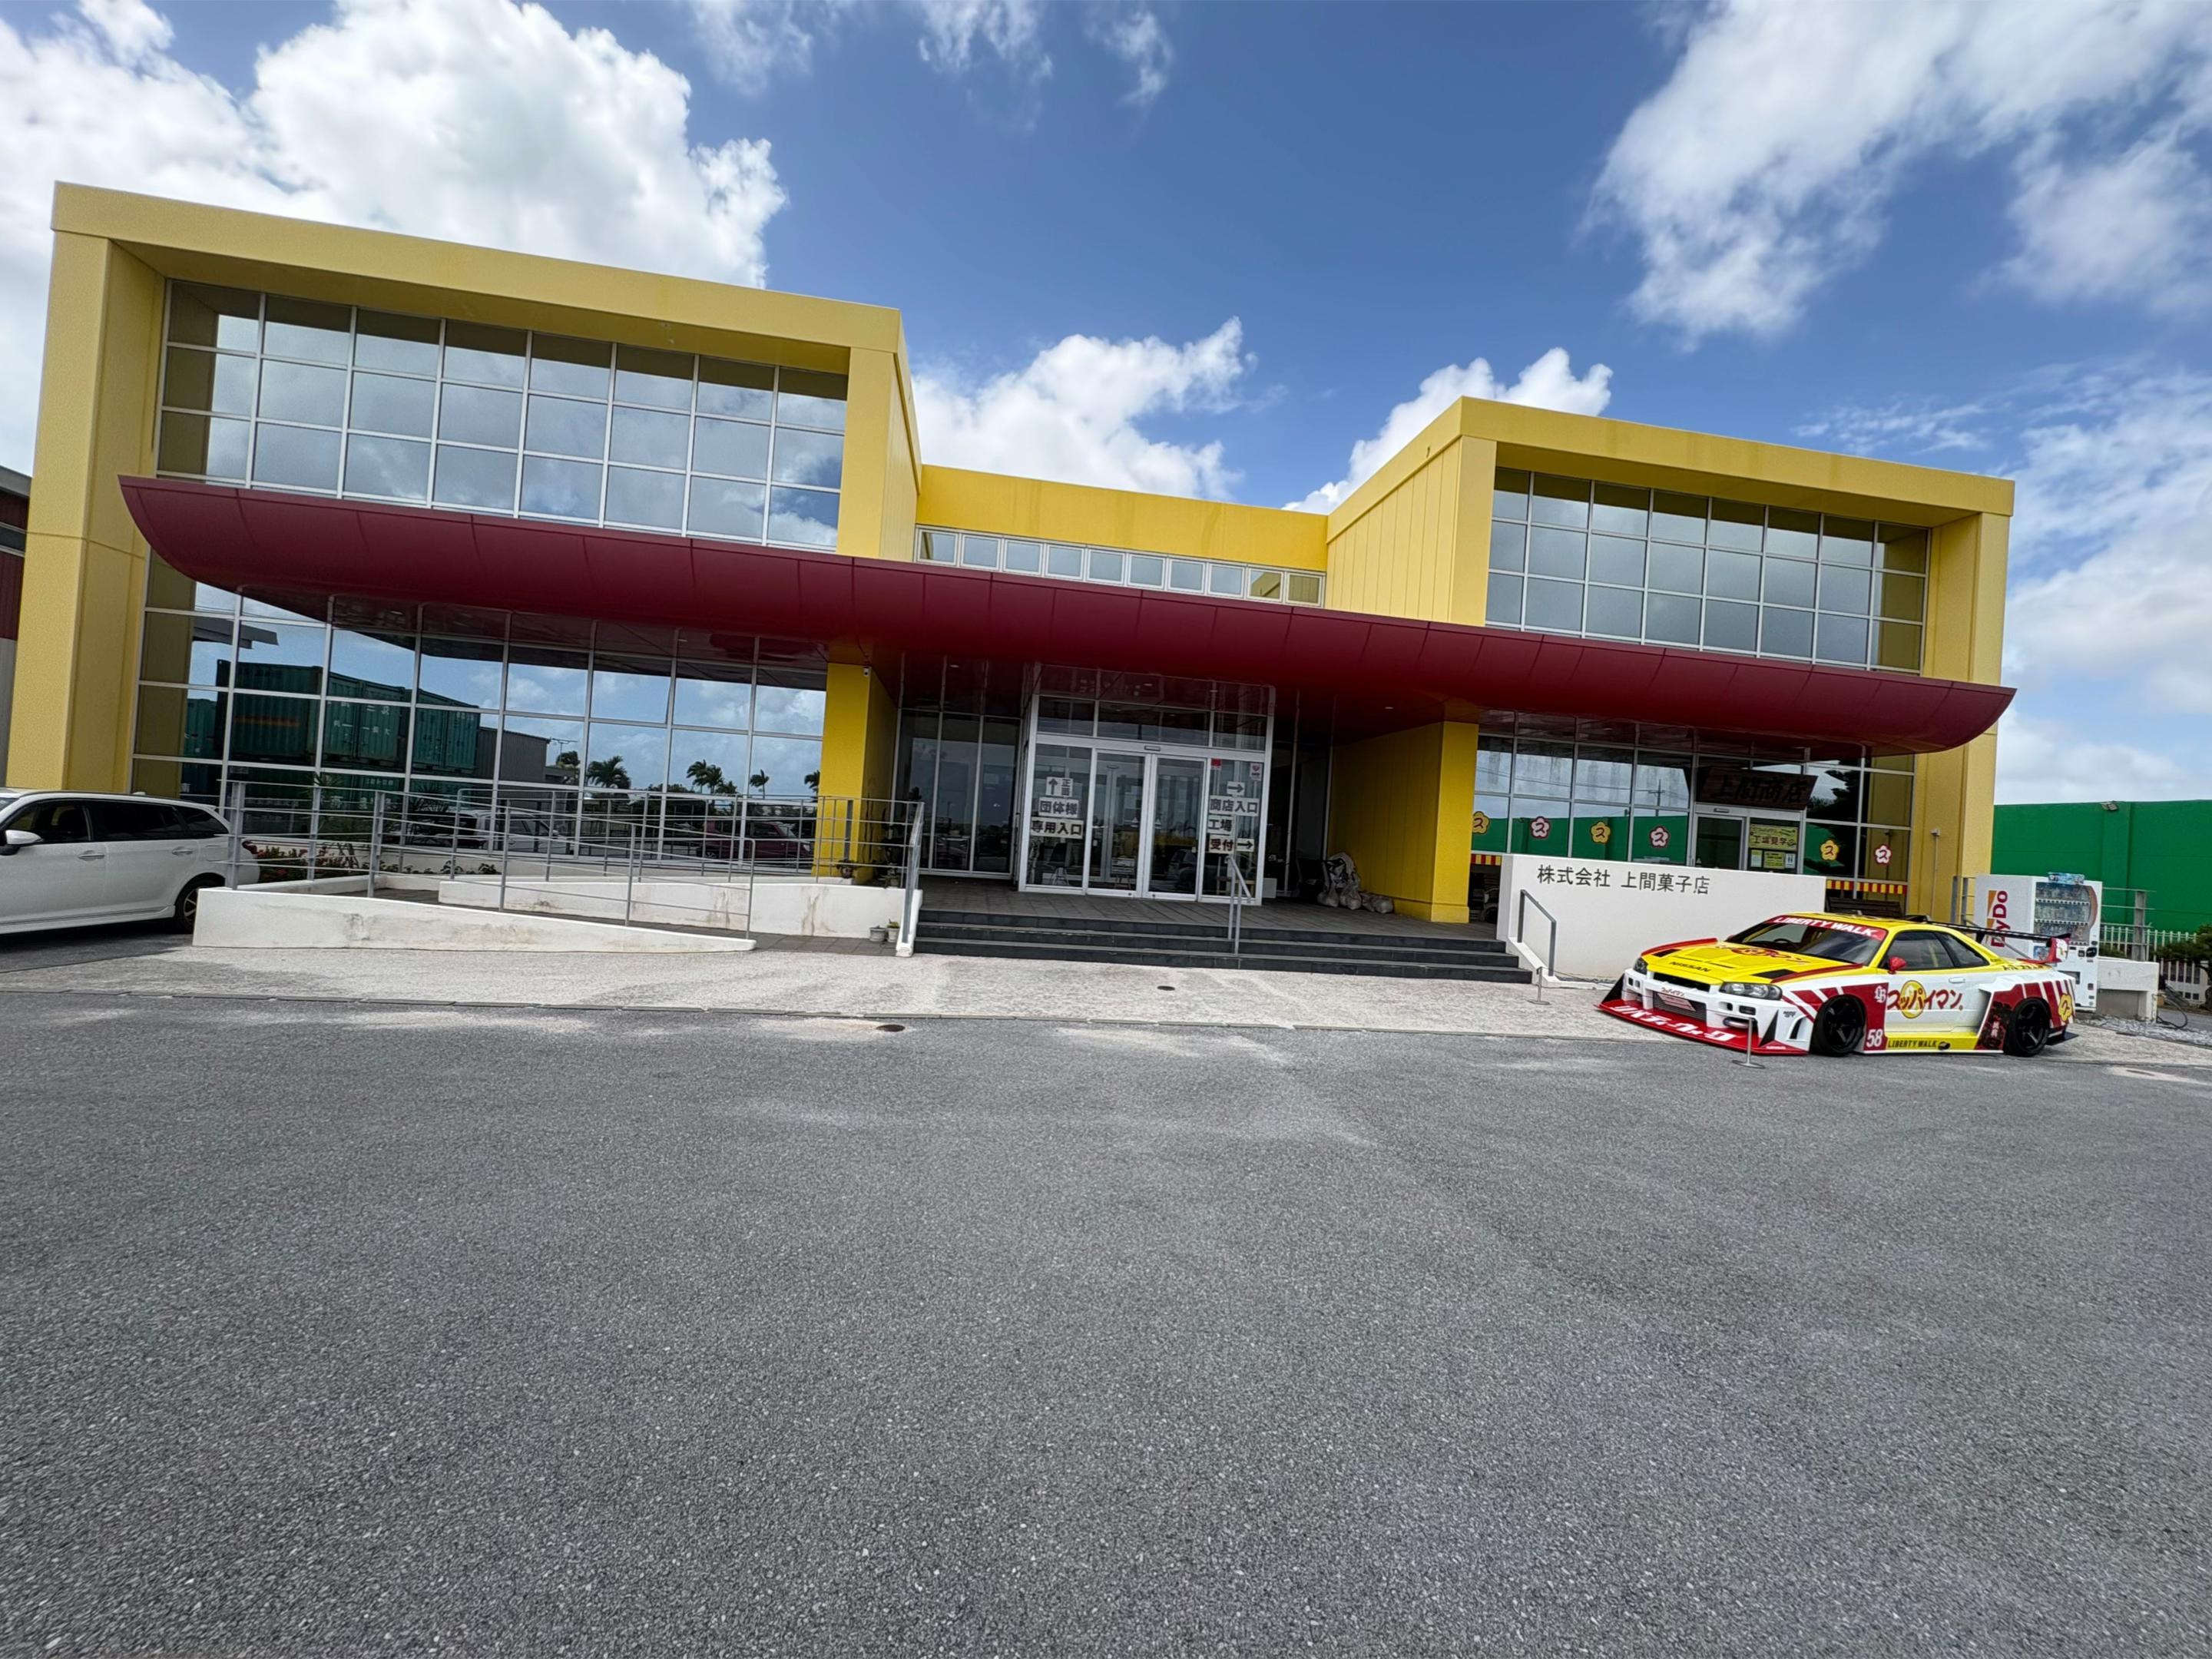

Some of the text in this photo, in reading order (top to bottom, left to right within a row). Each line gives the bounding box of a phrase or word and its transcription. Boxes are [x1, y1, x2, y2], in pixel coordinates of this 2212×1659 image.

[1040, 800, 1078, 815] 団体様
[1210, 798, 1259, 814] 商店入口
[1031, 820, 1082, 836] 専用入口
[1208, 819, 1232, 832] 工場
[1210, 838, 1233, 851] 受付
[1537, 864, 1710, 894] 株式会社 上間菓子店
[1773, 916, 1876, 936] LIBERTY WALK
[1669, 961, 1710, 972] NISSAN
[1866, 1028, 1883, 1048] 58
[1888, 1039, 1917, 1048] LIBERTY
